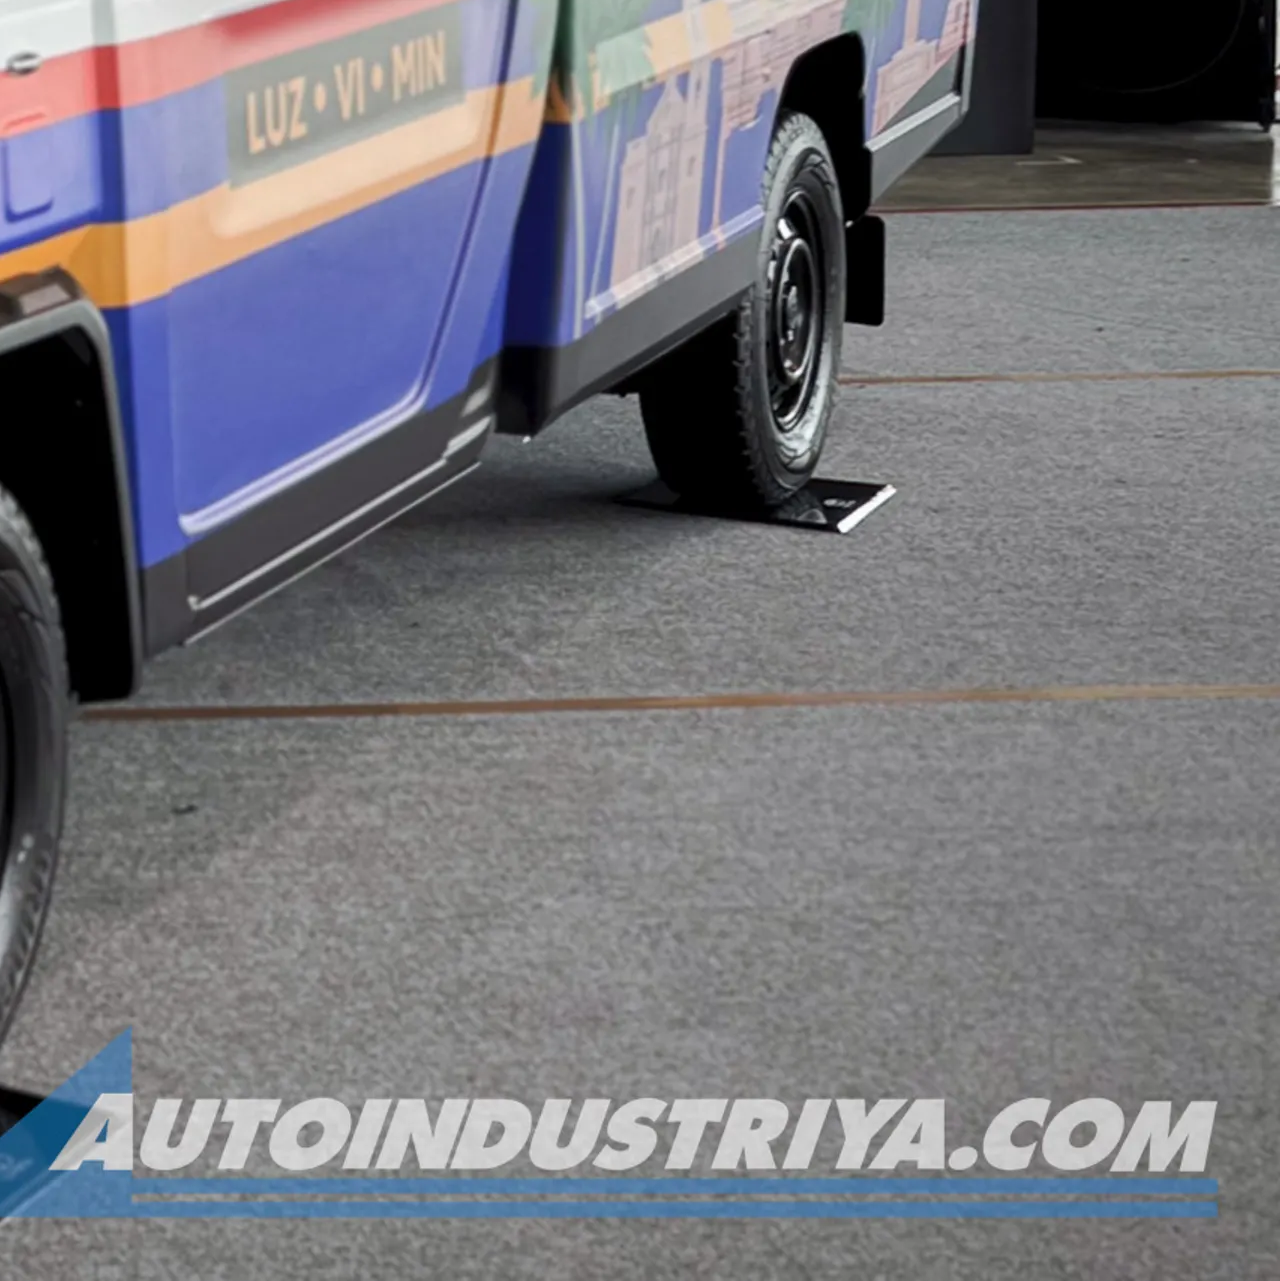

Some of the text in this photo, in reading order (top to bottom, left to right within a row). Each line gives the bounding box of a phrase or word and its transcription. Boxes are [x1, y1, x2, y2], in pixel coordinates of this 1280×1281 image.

[245, 28, 447, 156] LUZ VI MIN
